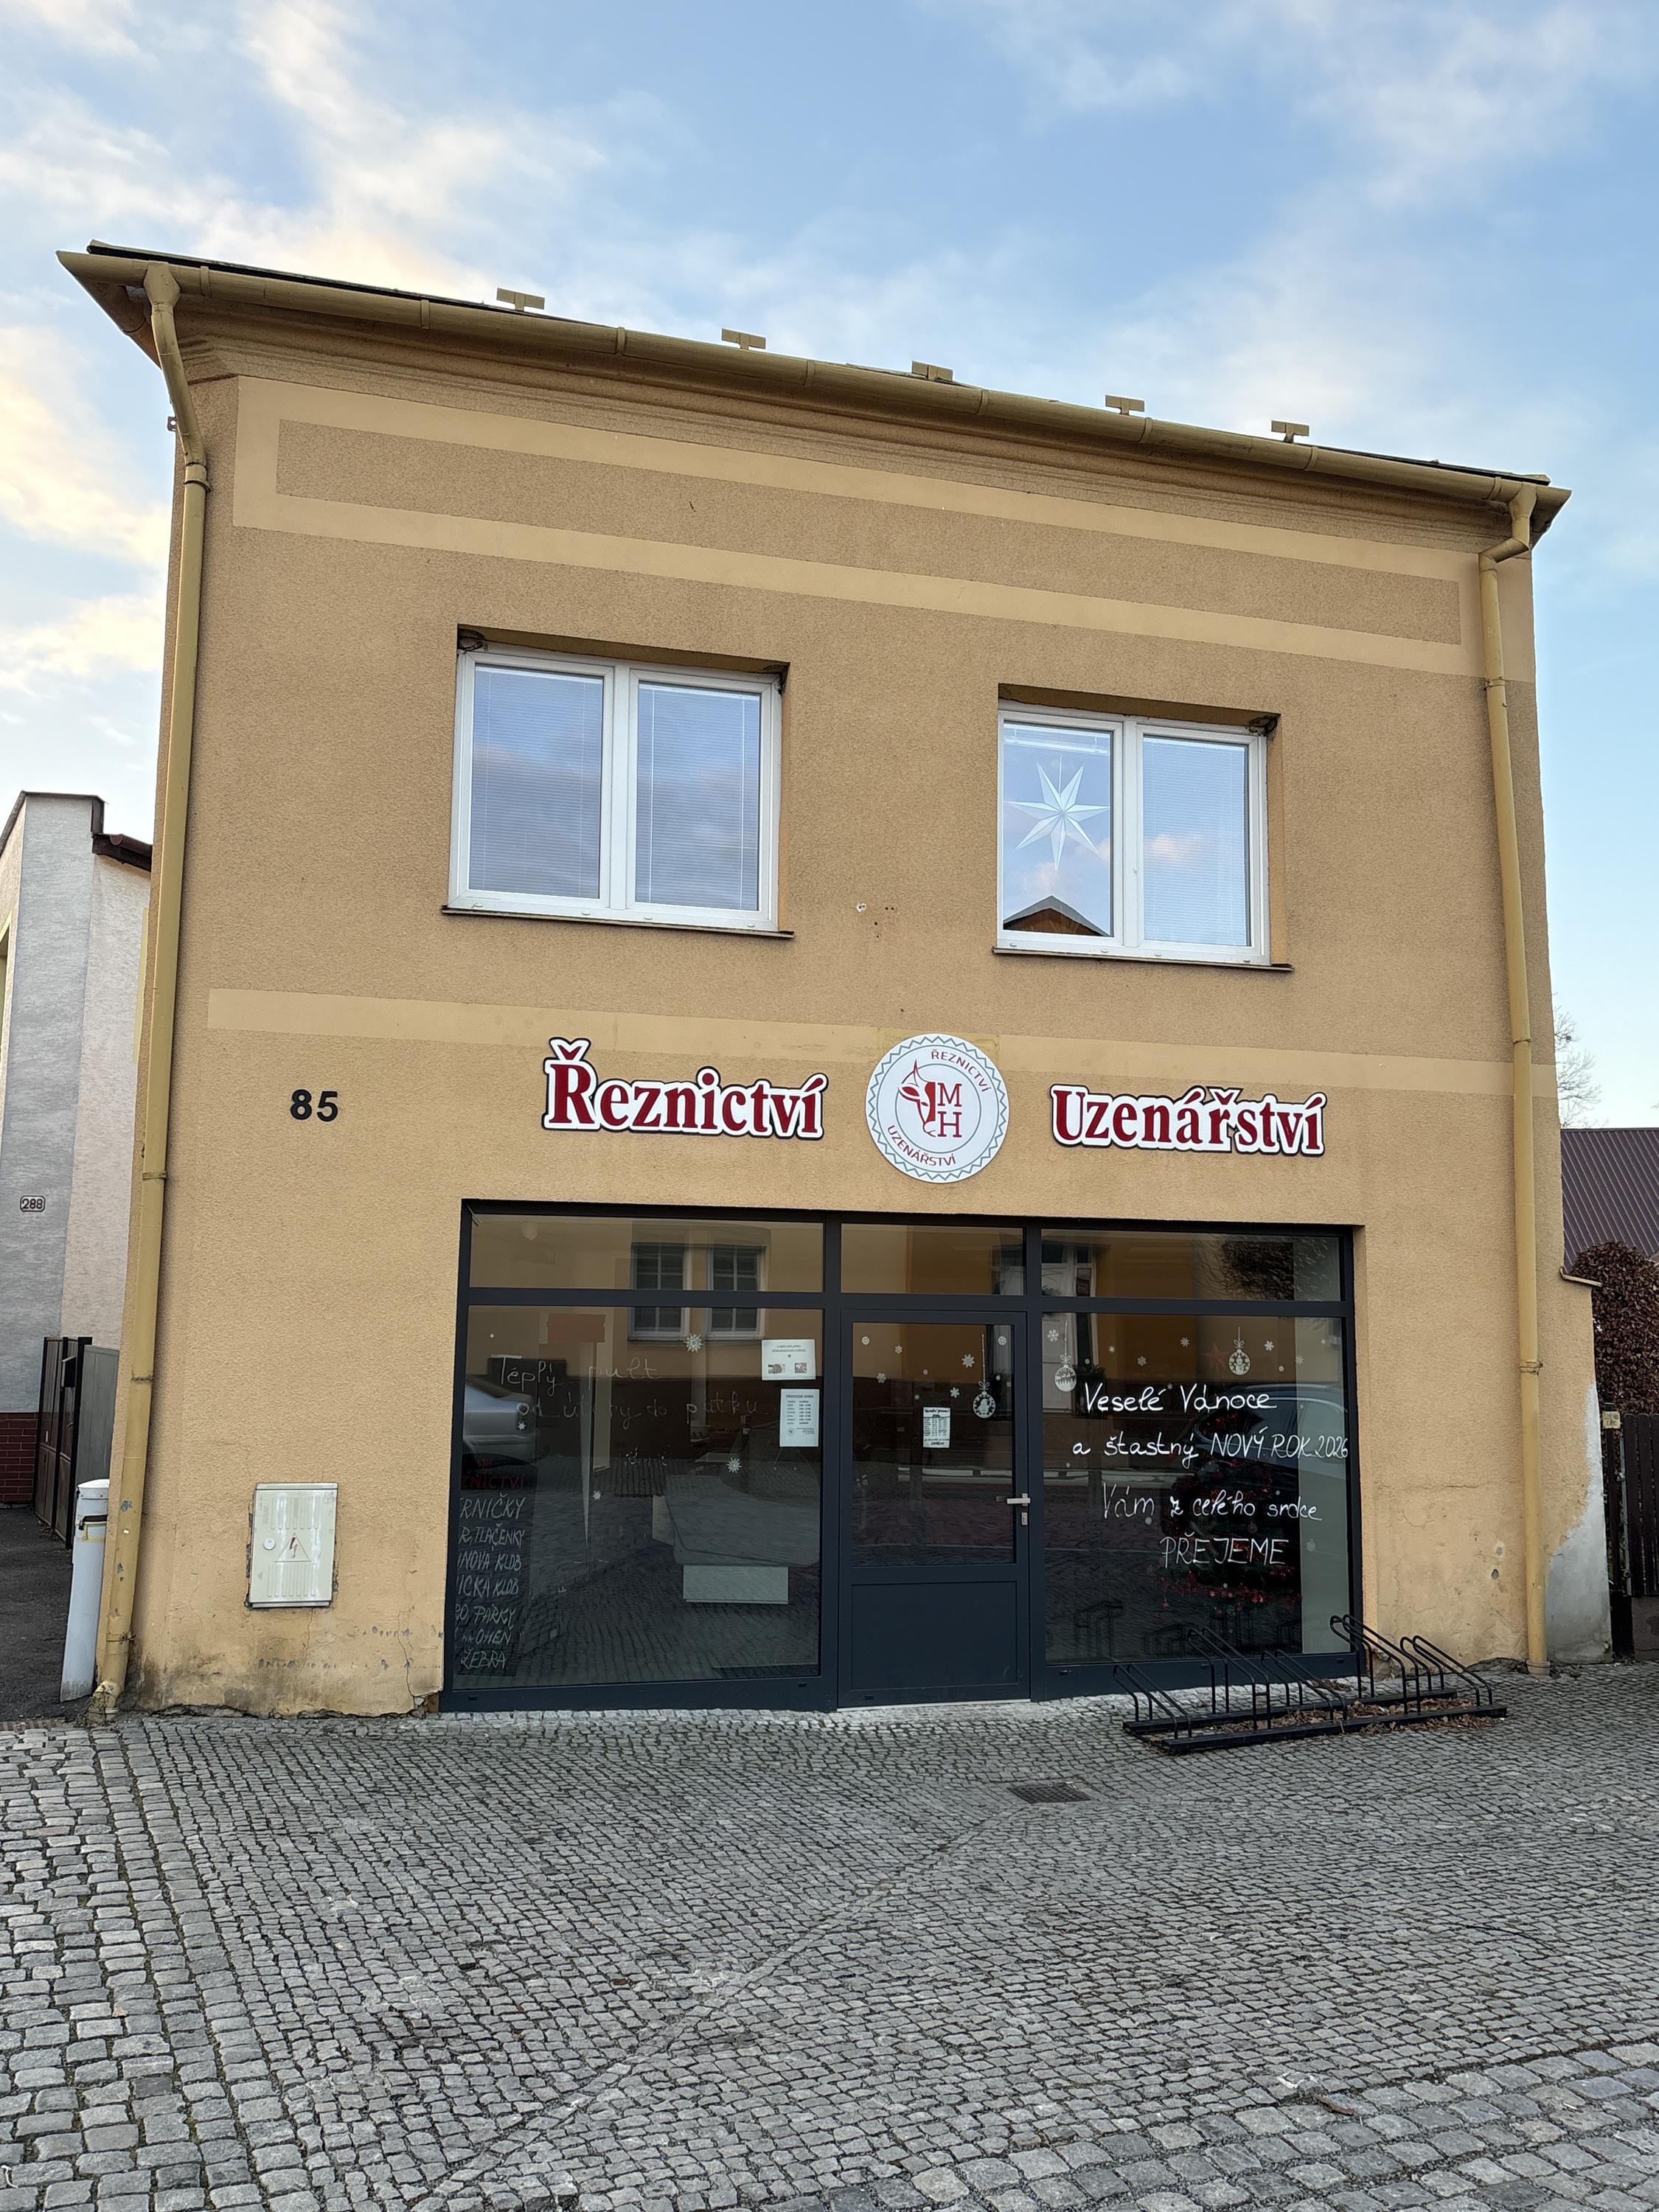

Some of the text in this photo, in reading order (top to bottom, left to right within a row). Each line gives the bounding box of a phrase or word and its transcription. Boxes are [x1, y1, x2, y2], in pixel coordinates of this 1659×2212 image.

[931, 1048, 992, 1093] ŘEZNICTVÍ
[547, 1043, 826, 1134] Řeznictví
[290, 1089, 338, 1122] 85
[1052, 1090, 1324, 1151] Uzenářství
[887, 1124, 956, 1167] UZENÁŘSTVÍ
[22, 1198, 44, 1209] 288
[588, 1357, 658, 1391] pult
[647, 1399, 667, 1416] do
[1084, 1382, 1278, 1413] Veselé Vánoce
[1072, 1441, 1091, 1455] a
[1209, 1427, 1269, 1458] NOVÝ
[1270, 1433, 1312, 1459] ROK
[1315, 1434, 1349, 1460] 2026
[460, 1492, 526, 1520] RNIČKY
[1103, 1482, 1155, 1519] Vám
[1192, 1489, 1256, 1517] celého
[1267, 1495, 1323, 1521] srdce
[1160, 1531, 1290, 1569] PŘEJEME
[460, 1647, 507, 1670] ŽEBRA
